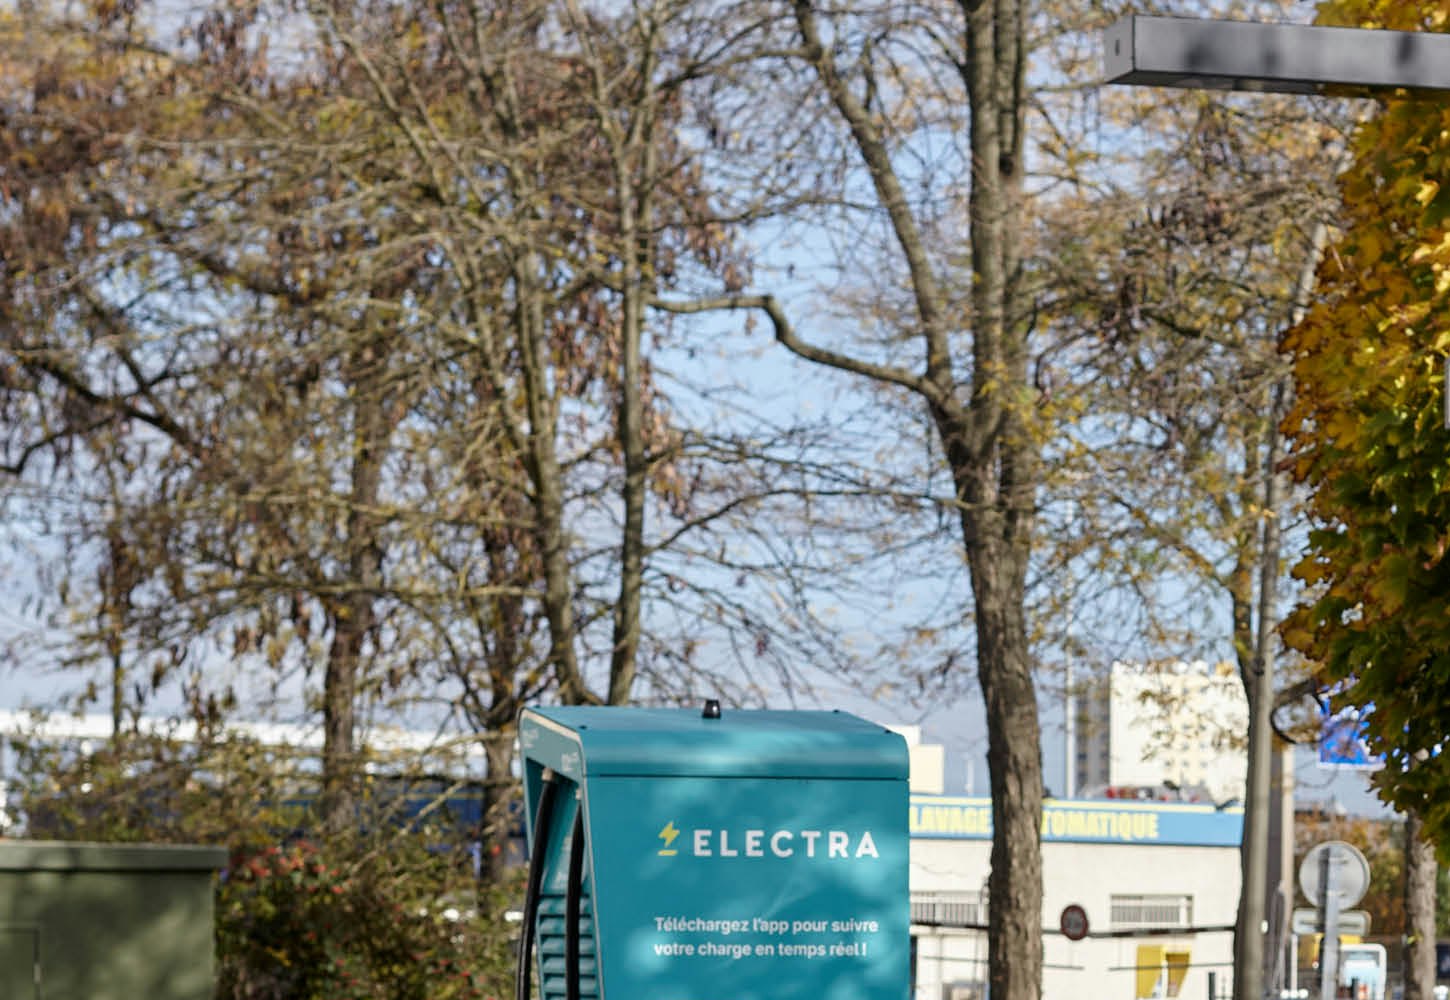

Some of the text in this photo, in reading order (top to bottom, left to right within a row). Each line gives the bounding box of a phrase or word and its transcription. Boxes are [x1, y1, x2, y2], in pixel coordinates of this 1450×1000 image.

[1042, 808, 1159, 841] TOMATIQUE
[694, 830, 879, 858] ELECTRA
[655, 917, 879, 935] Téléchargez l’app pour suivre
[652, 943, 694, 956] votre
[698, 942, 752, 959] charge
[755, 945, 774, 956] en
[778, 943, 826, 959] temps
[829, 942, 859, 956] réel
